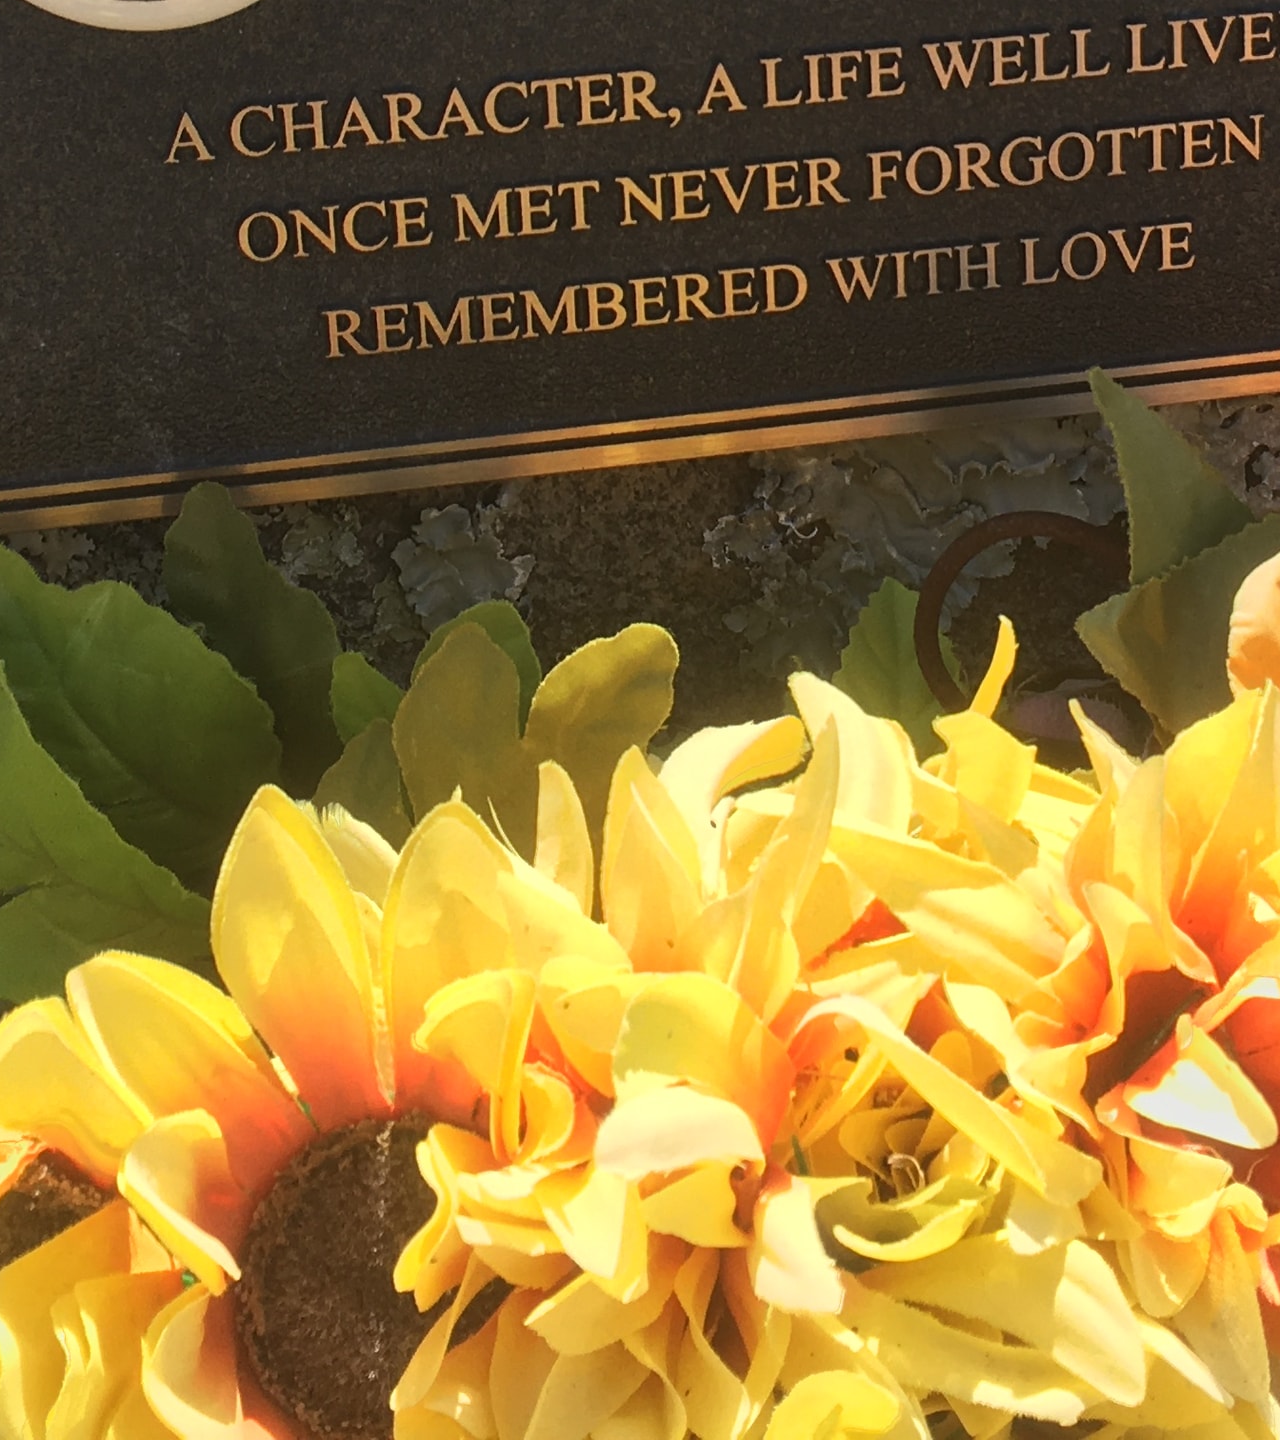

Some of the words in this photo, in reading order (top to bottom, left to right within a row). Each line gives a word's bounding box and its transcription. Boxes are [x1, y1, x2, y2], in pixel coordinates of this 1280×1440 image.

[164, 112, 215, 163] A
[231, 71, 681, 156] CHARACTER,
[698, 63, 747, 114] A
[760, 47, 905, 108] LIFE
[923, 29, 1110, 90] WELL
[239, 197, 433, 261] ONCE
[451, 180, 599, 242] MET
[615, 158, 850, 225] NEVER
[867, 115, 1264, 200] FORGOTTEN
[322, 264, 807, 357] REMEMBERED
[826, 242, 1000, 303] WITH
[1021, 222, 1195, 285] LOVE
